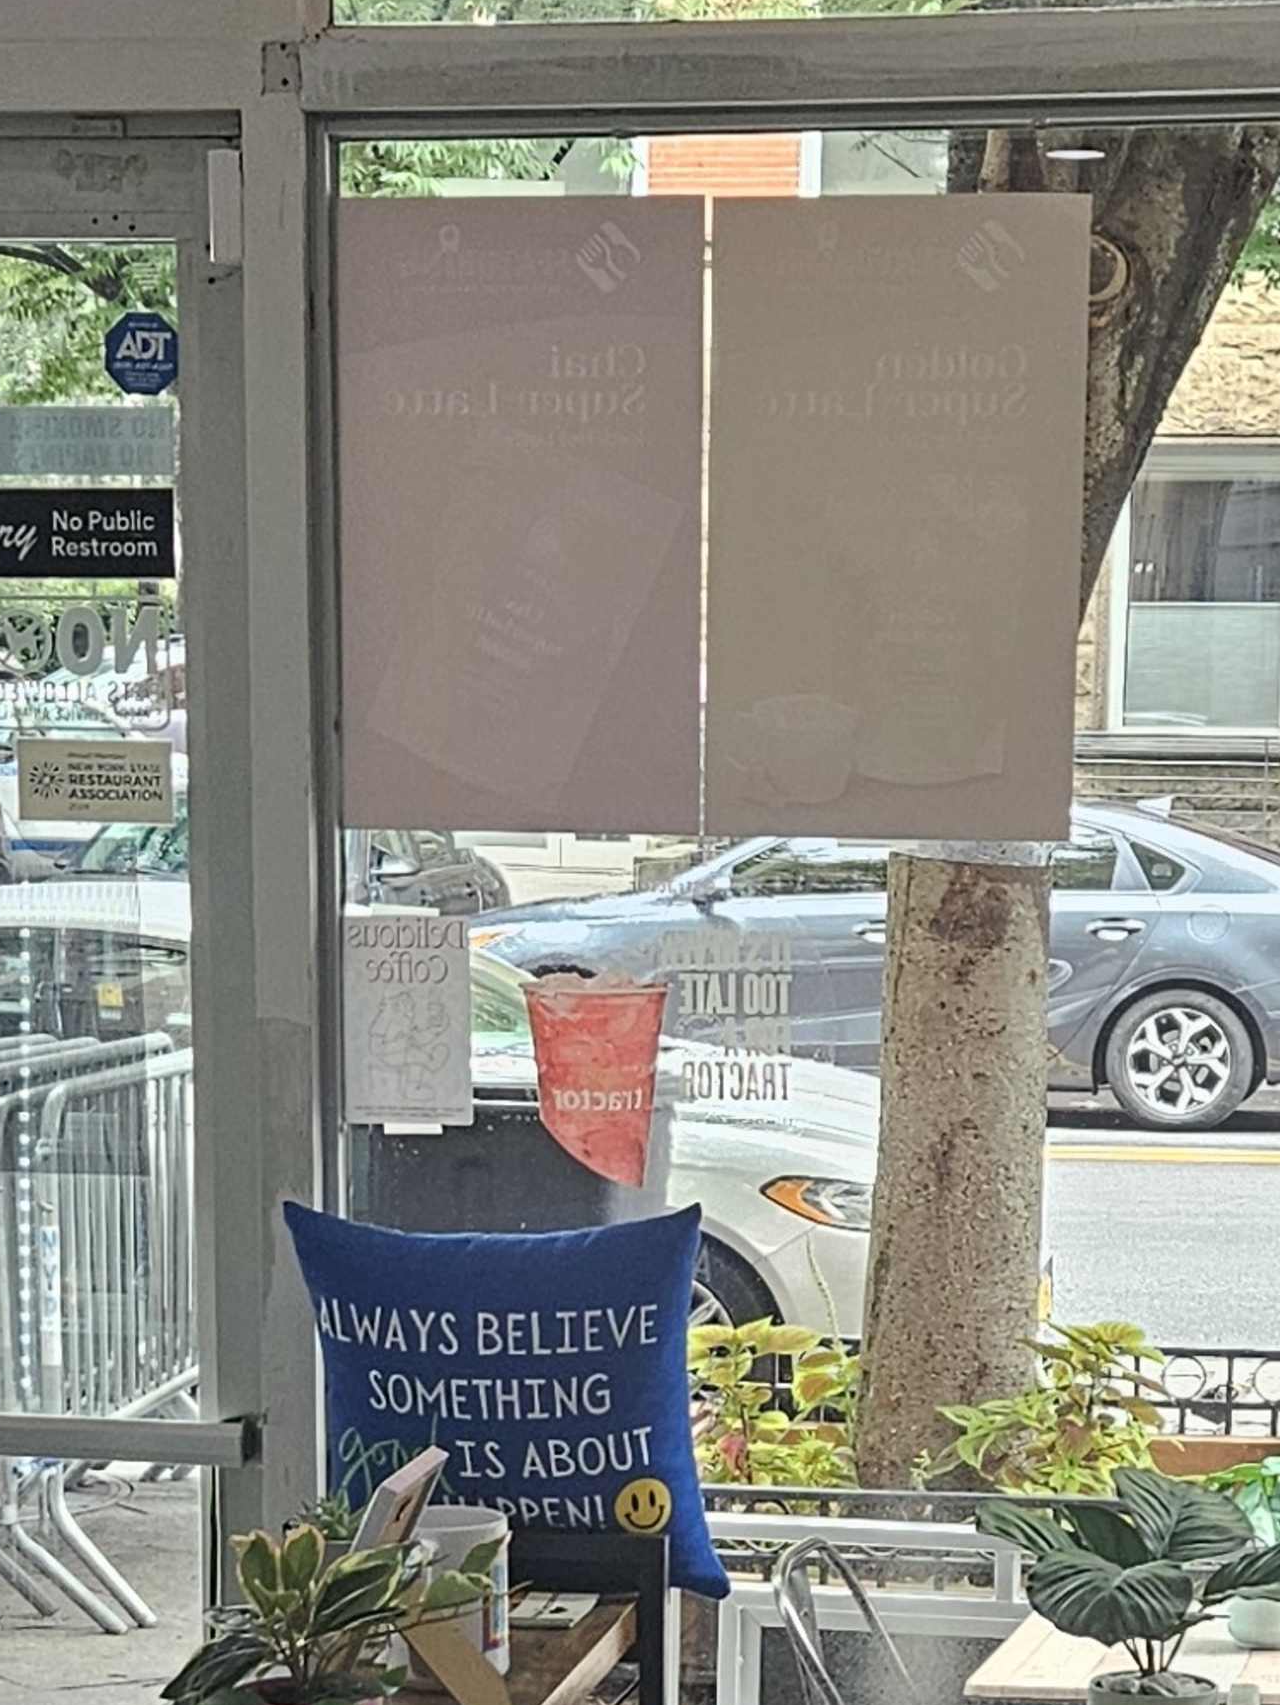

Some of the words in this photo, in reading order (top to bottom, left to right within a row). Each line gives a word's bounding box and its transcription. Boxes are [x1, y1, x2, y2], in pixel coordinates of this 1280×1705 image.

[116, 330, 173, 361] ADT
[52, 510, 83, 532] No
[88, 510, 156, 532] Public
[51, 536, 158, 557] Restroom
[68, 773, 162, 787] RESTAURANT
[68, 788, 163, 802] ASSOCIATION
[321, 1295, 458, 1356] ALWAYS
[476, 1303, 659, 1356] BELIEVE
[368, 1369, 612, 1421] SOMETHING
[455, 1439, 507, 1479] IS
[522, 1426, 653, 1479] ABOUT
